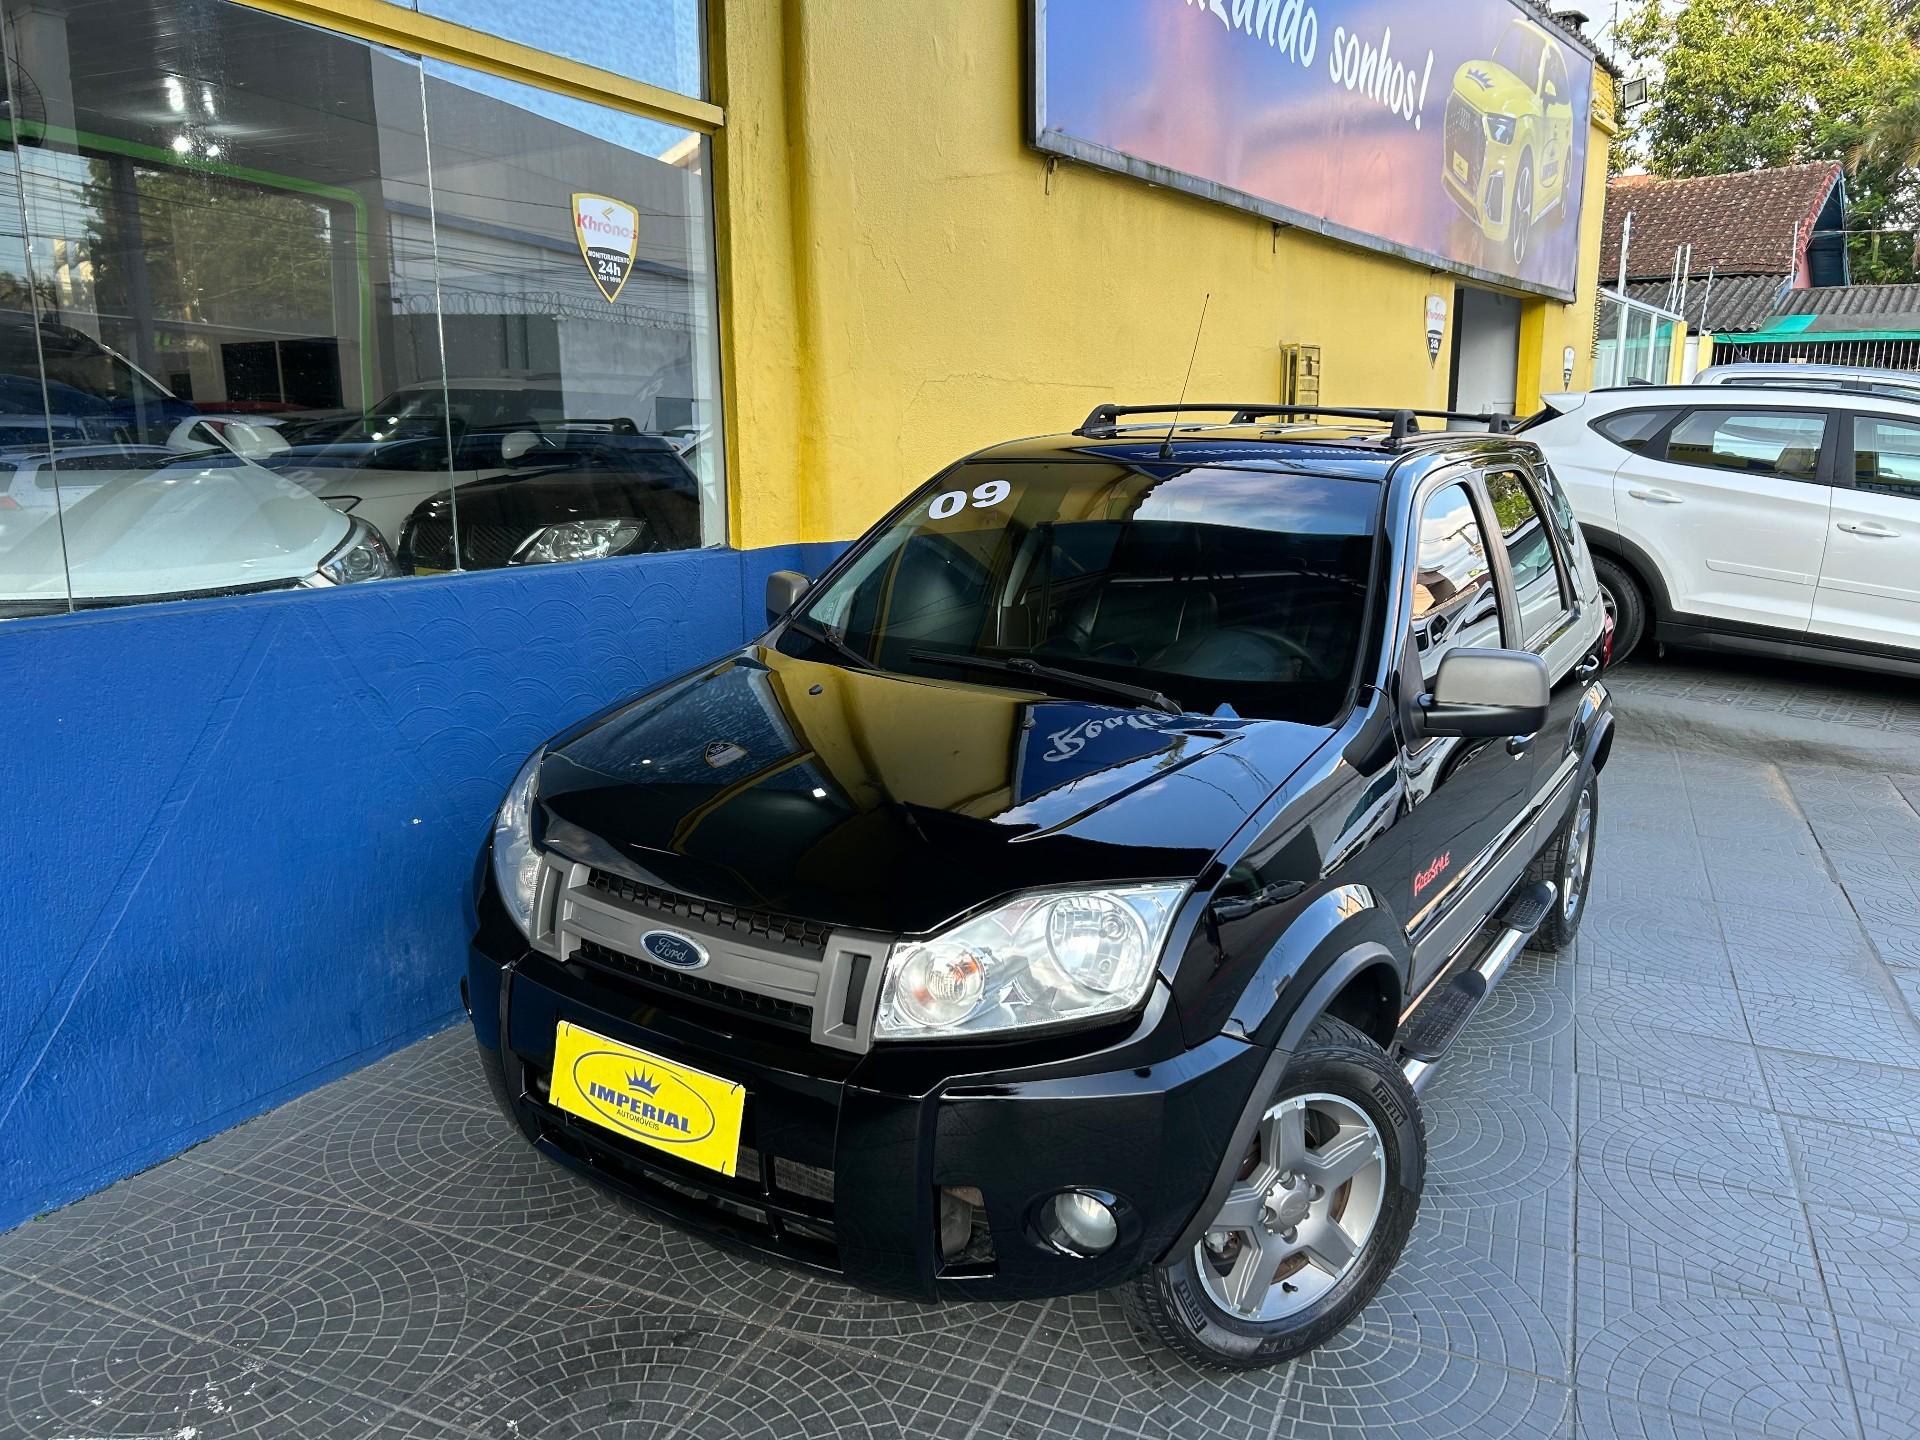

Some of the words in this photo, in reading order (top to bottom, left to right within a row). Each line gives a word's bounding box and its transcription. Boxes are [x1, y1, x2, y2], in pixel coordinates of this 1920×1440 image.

[1329, 26, 1434, 130] sonhos!
[577, 213, 639, 240] Khronos
[598, 261, 621, 276] 24h
[928, 480, 1011, 520] 09
[653, 938, 689, 963] Ford
[589, 1081, 692, 1134] IMPERIAL
[1372, 1082, 1408, 1128] PIRELLI
